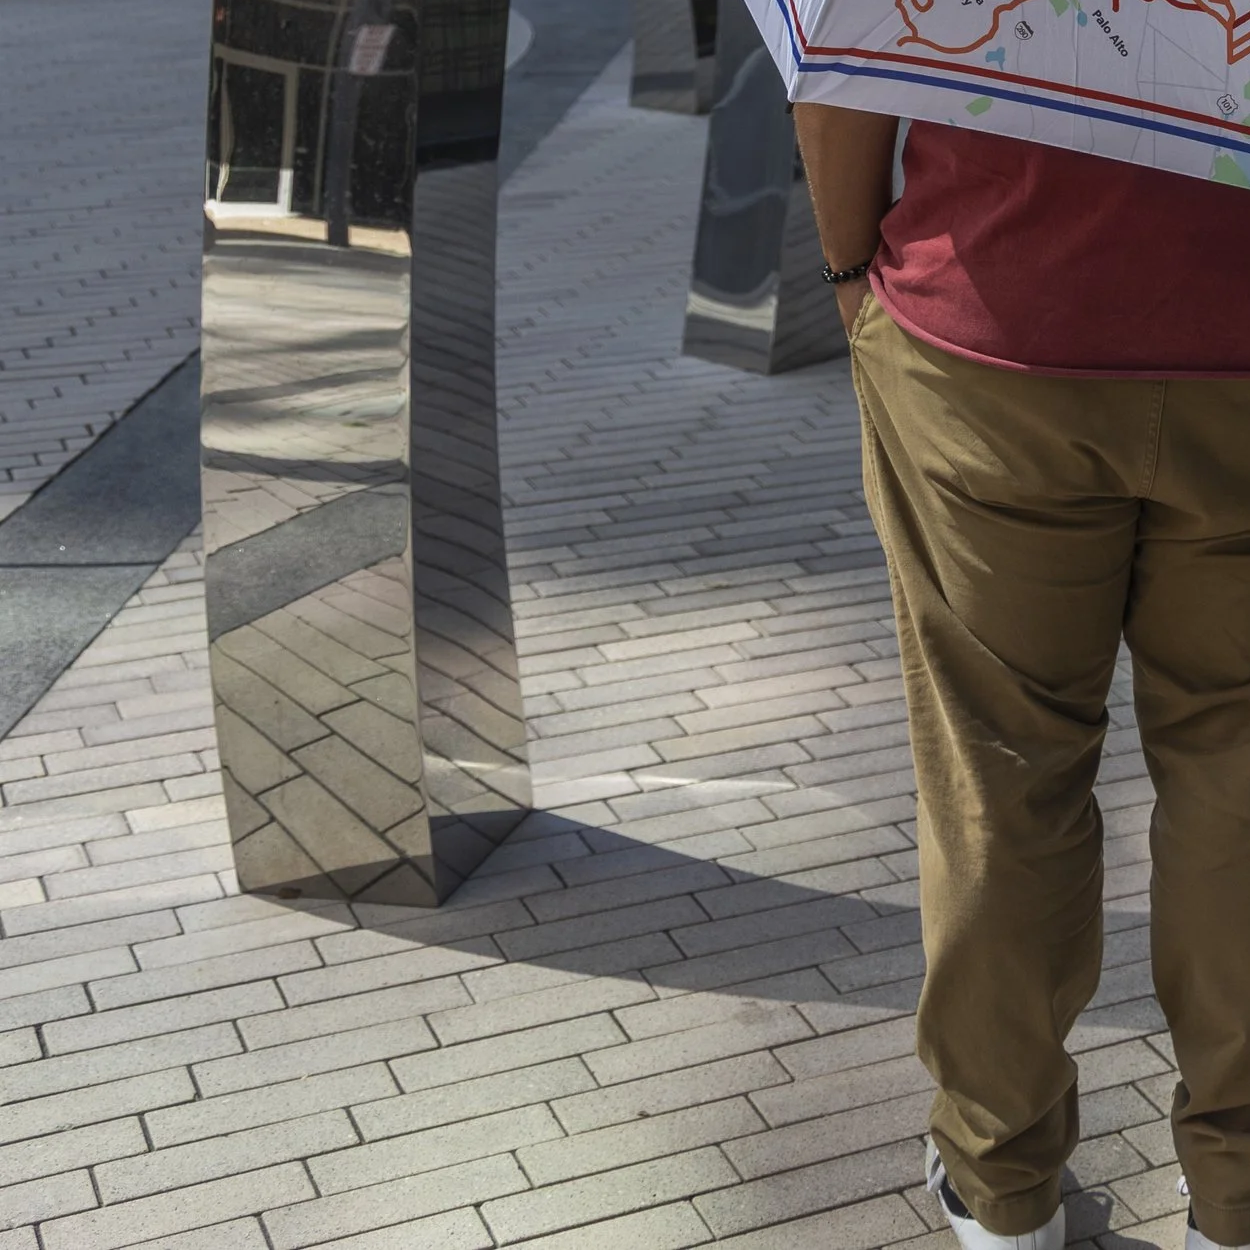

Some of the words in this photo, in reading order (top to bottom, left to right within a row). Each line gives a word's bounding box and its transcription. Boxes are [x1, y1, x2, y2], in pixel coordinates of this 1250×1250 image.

[1016, 26, 1029, 39] 280
[1092, 10, 1111, 34] Palo
[1109, 33, 1128, 57] Alto
[1221, 99, 1232, 111] 101
